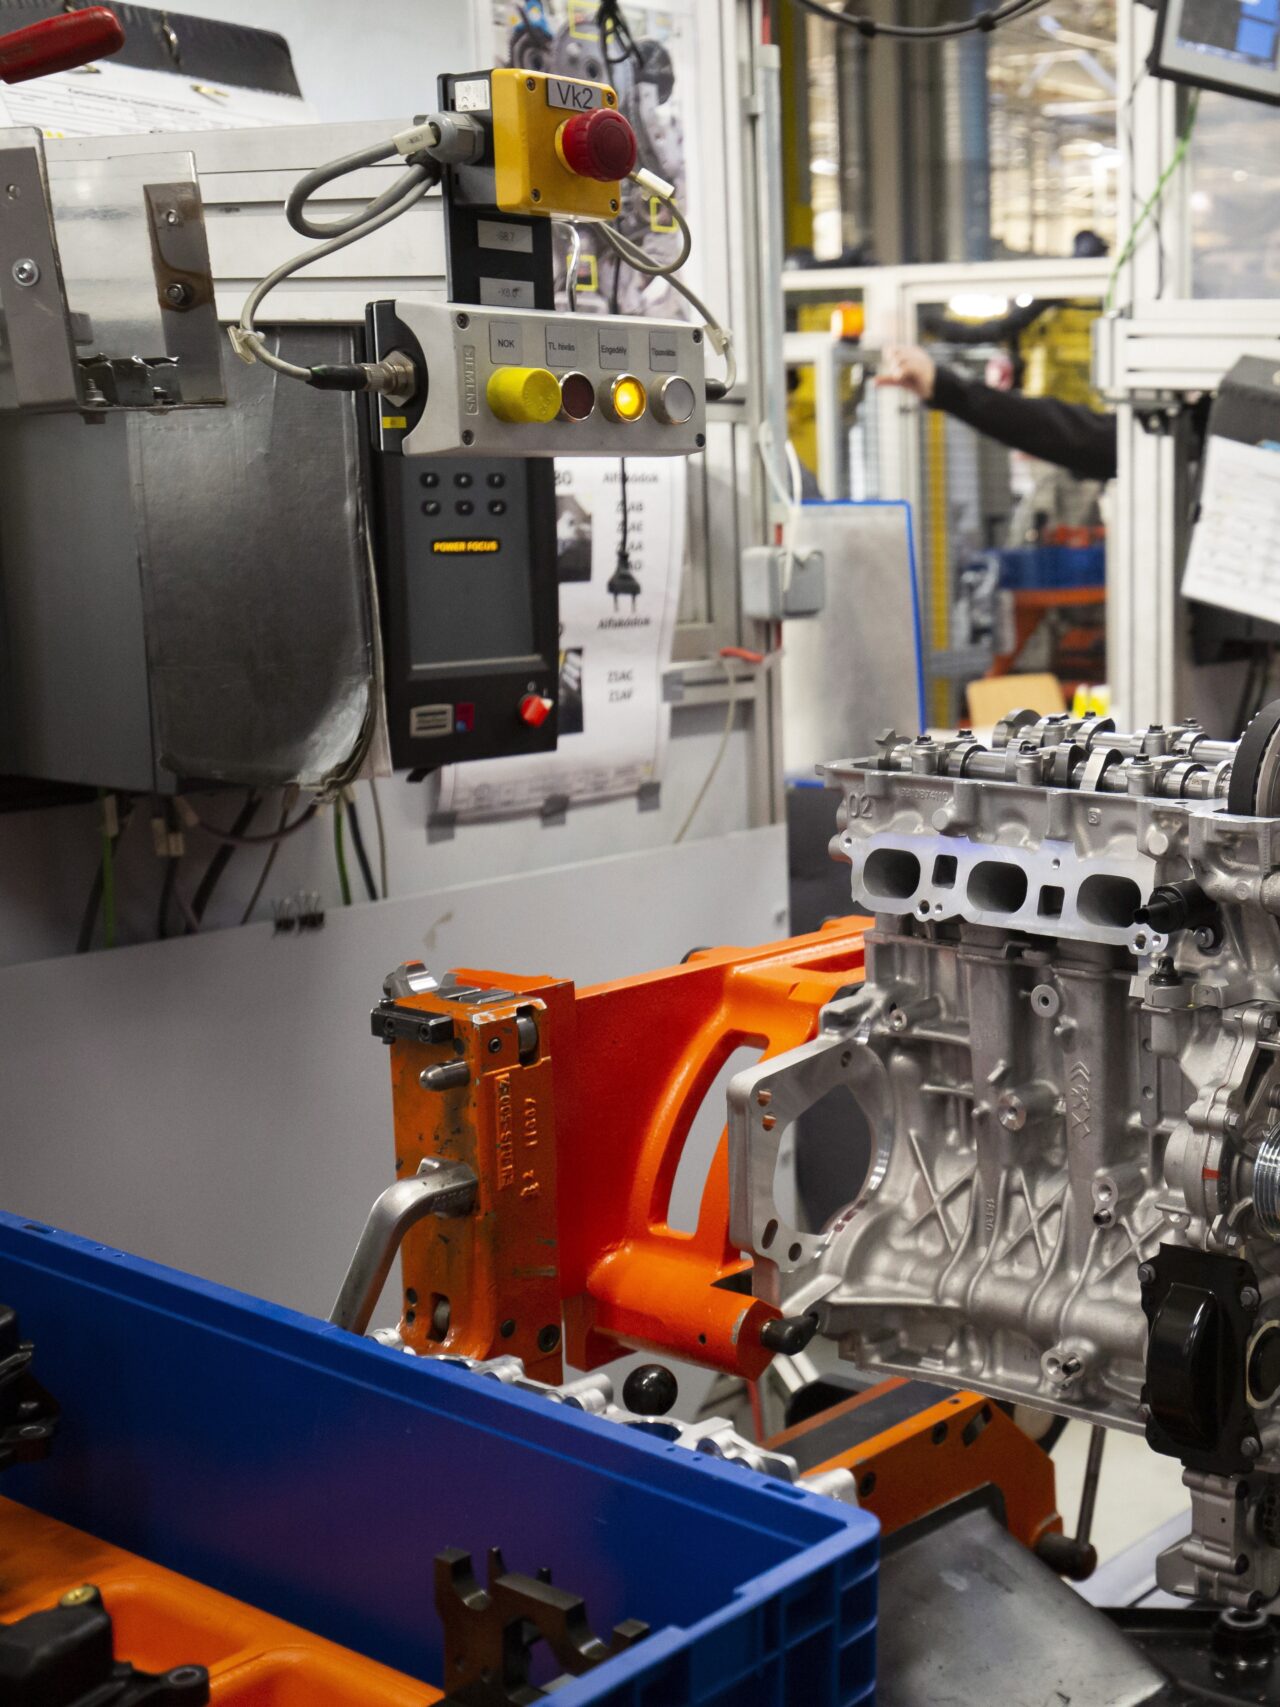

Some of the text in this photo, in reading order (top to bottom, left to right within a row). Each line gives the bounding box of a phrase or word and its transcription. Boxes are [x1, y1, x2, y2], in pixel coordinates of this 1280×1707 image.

[557, 81, 594, 109] Vk2
[497, 339, 515, 348] NOK
[465, 350, 478, 413] SIEMENS
[433, 541, 498, 552] POWER FOCUS
